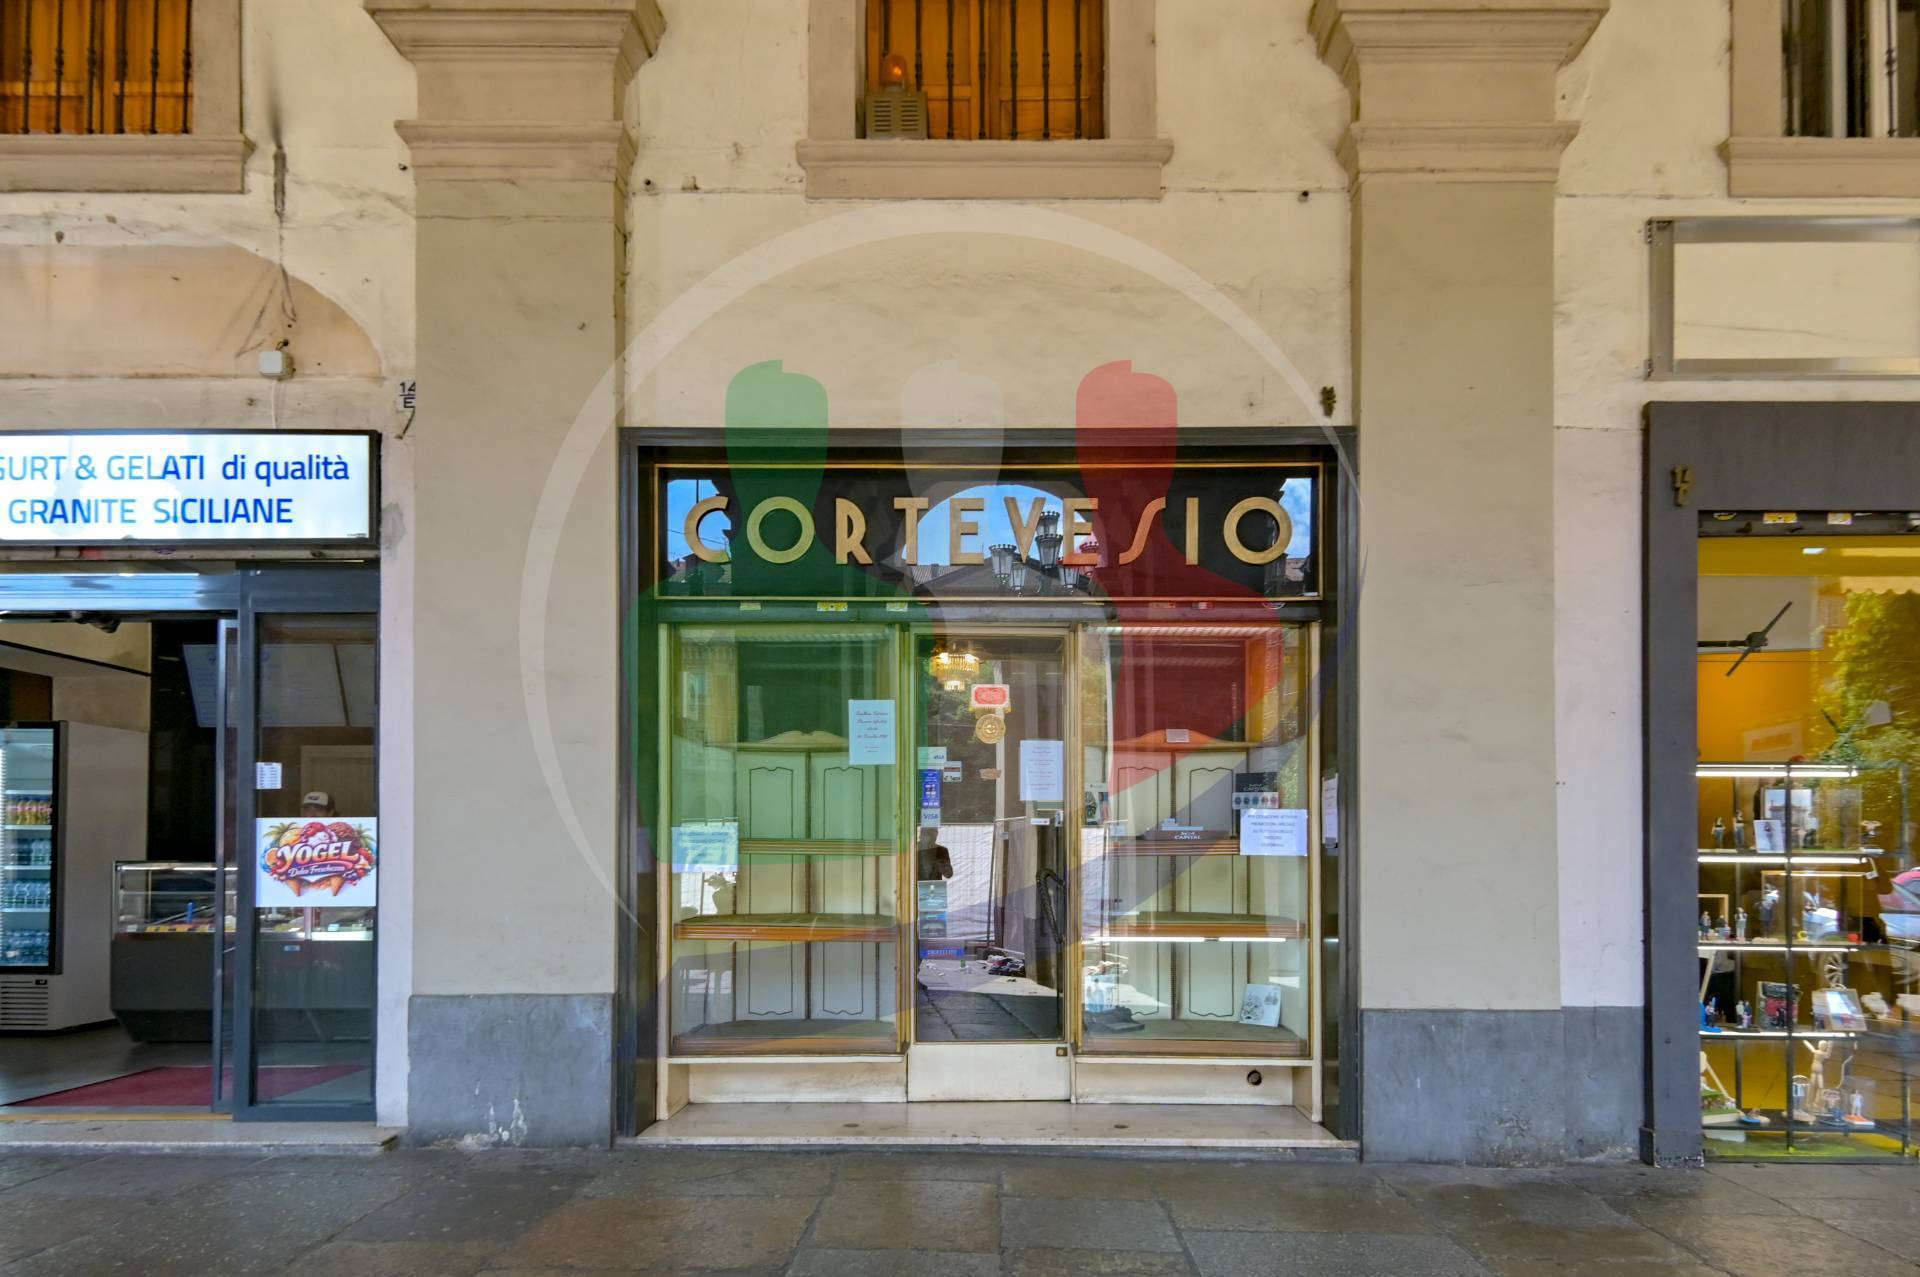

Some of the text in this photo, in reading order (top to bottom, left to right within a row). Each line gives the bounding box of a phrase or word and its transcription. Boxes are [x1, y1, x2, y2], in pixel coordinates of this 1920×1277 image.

[0, 455, 350, 487] URT & GELATI di qualità
[9, 498, 293, 524] GRANITE SICILIANE
[276, 841, 359, 873] YOGEL
